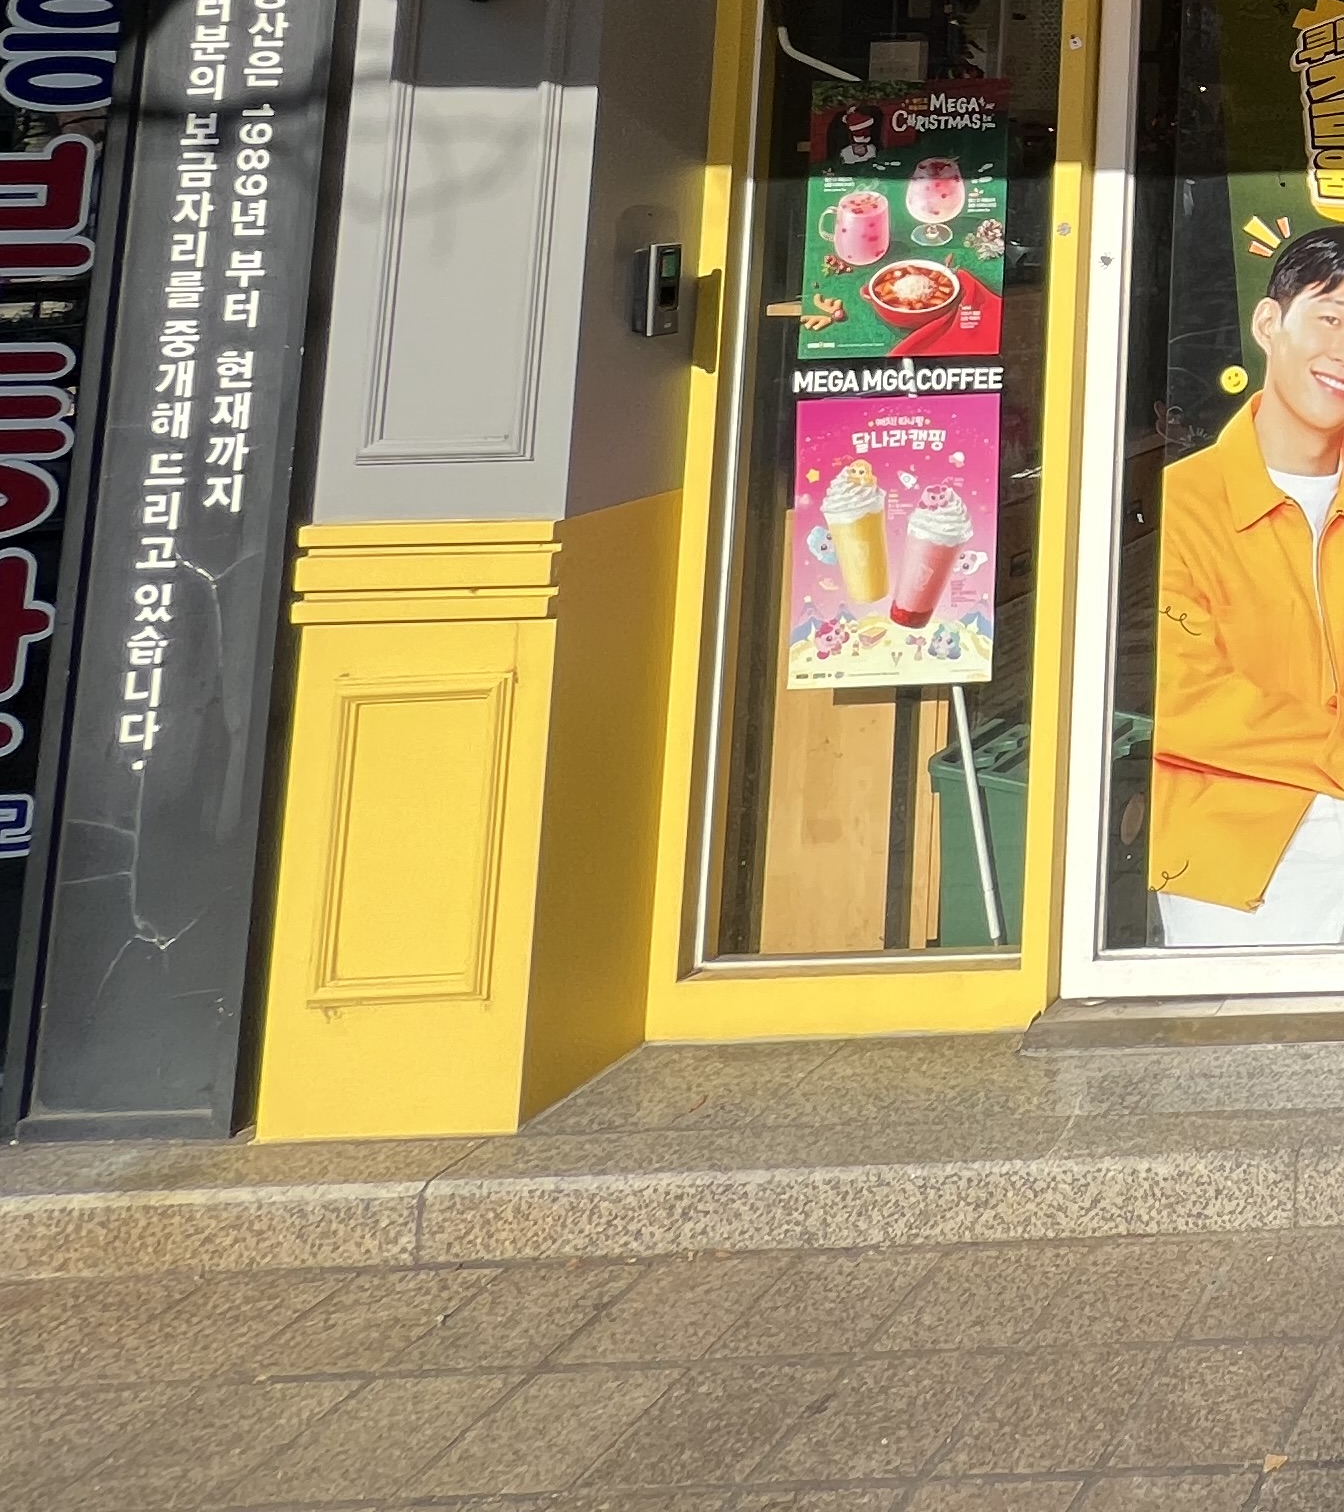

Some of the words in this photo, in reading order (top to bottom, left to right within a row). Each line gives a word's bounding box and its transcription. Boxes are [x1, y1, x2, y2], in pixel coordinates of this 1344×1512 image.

[891, 109, 981, 133] CHRISTMAS
[929, 92, 980, 114] MEGA
[164, 112, 221, 310] 보금자리를
[230, 102, 276, 237] 1989년
[222, 248, 268, 330] 부터
[150, 318, 201, 441] 중개해
[201, 348, 255, 513] 현재까지
[792, 370, 862, 393] MEGA
[915, 366, 1004, 391] COFFEE
[134, 451, 188, 571] 드리고
